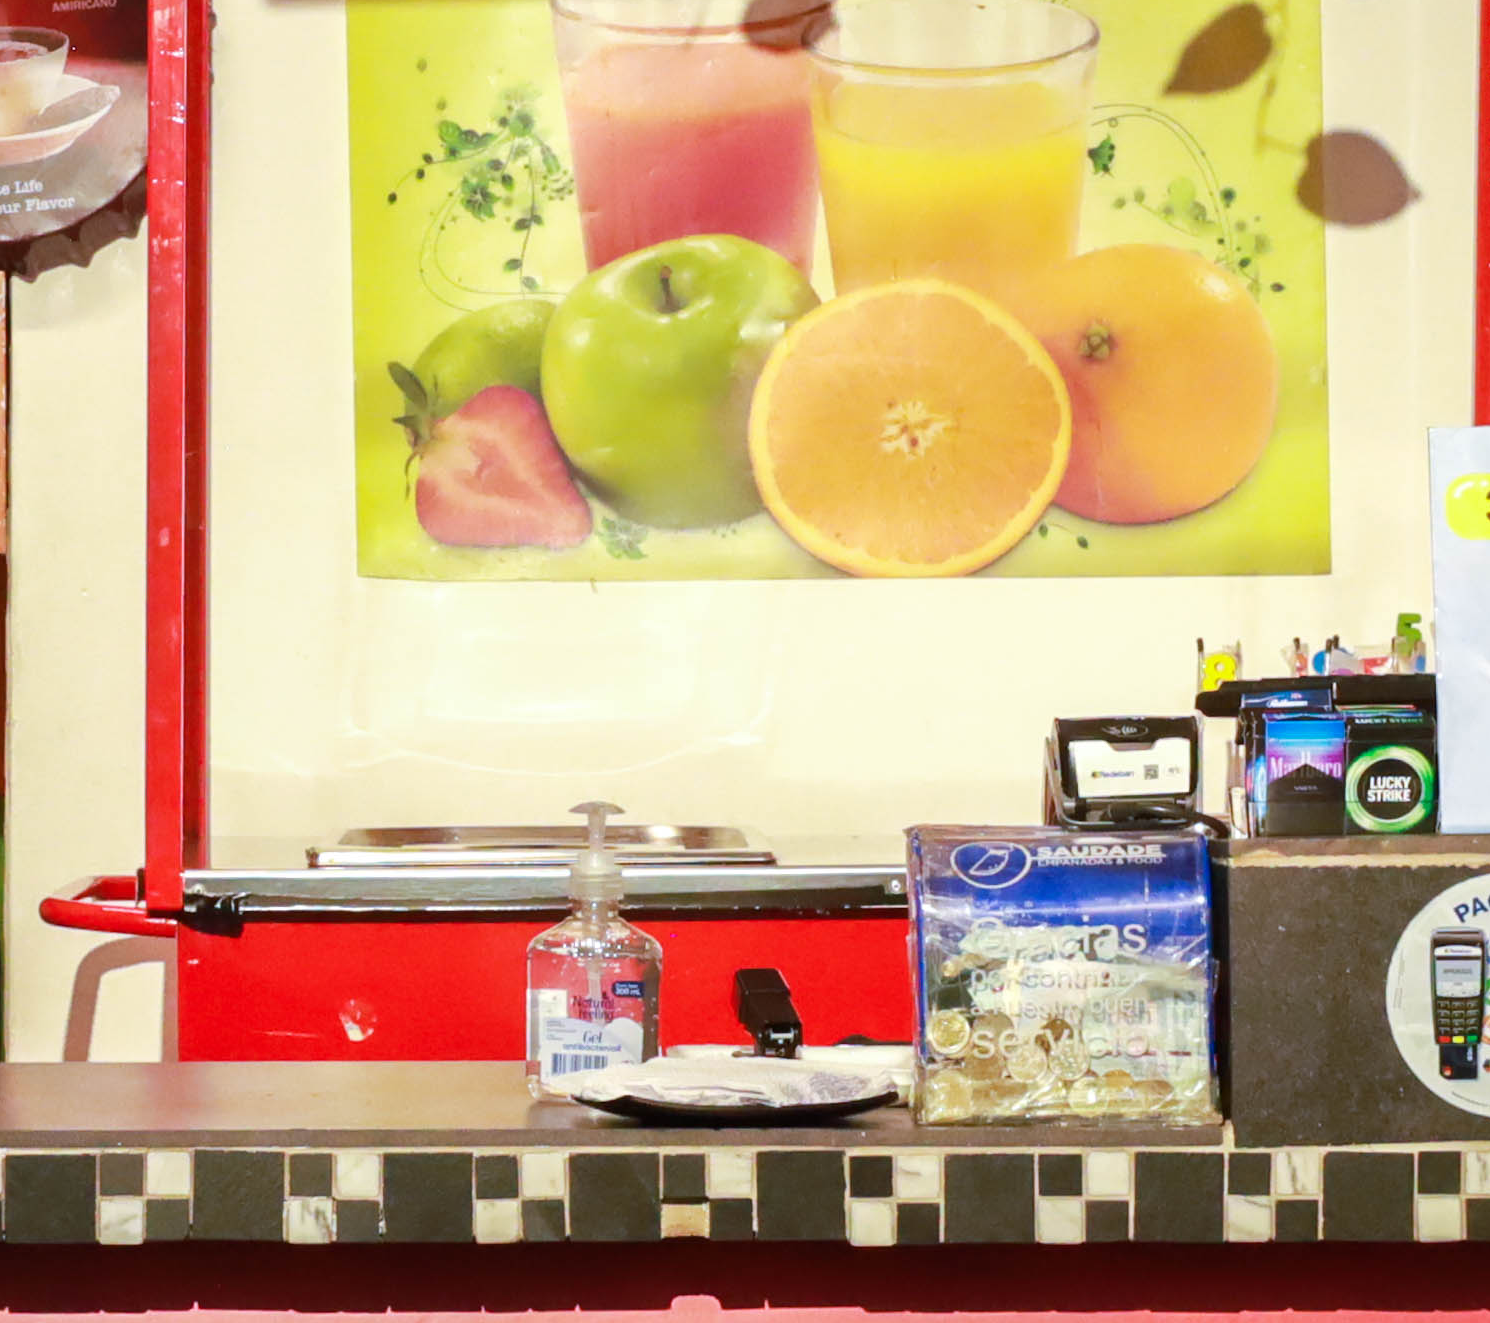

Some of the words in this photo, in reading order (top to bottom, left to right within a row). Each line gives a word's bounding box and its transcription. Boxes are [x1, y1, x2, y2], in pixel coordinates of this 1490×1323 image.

[15, 179, 44, 195] Life
[25, 195, 76, 213] Flavor
[1370, 776, 1410, 789] LUCKY
[1367, 788, 1411, 802] STRIKE
[1036, 844, 1163, 857] SAUDADE
[1037, 856, 1113, 866] EMPANADAS
[1127, 855, 1163, 865] FOOD
[970, 916, 1147, 958] Gracias
[583, 1030, 602, 1044] Gel
